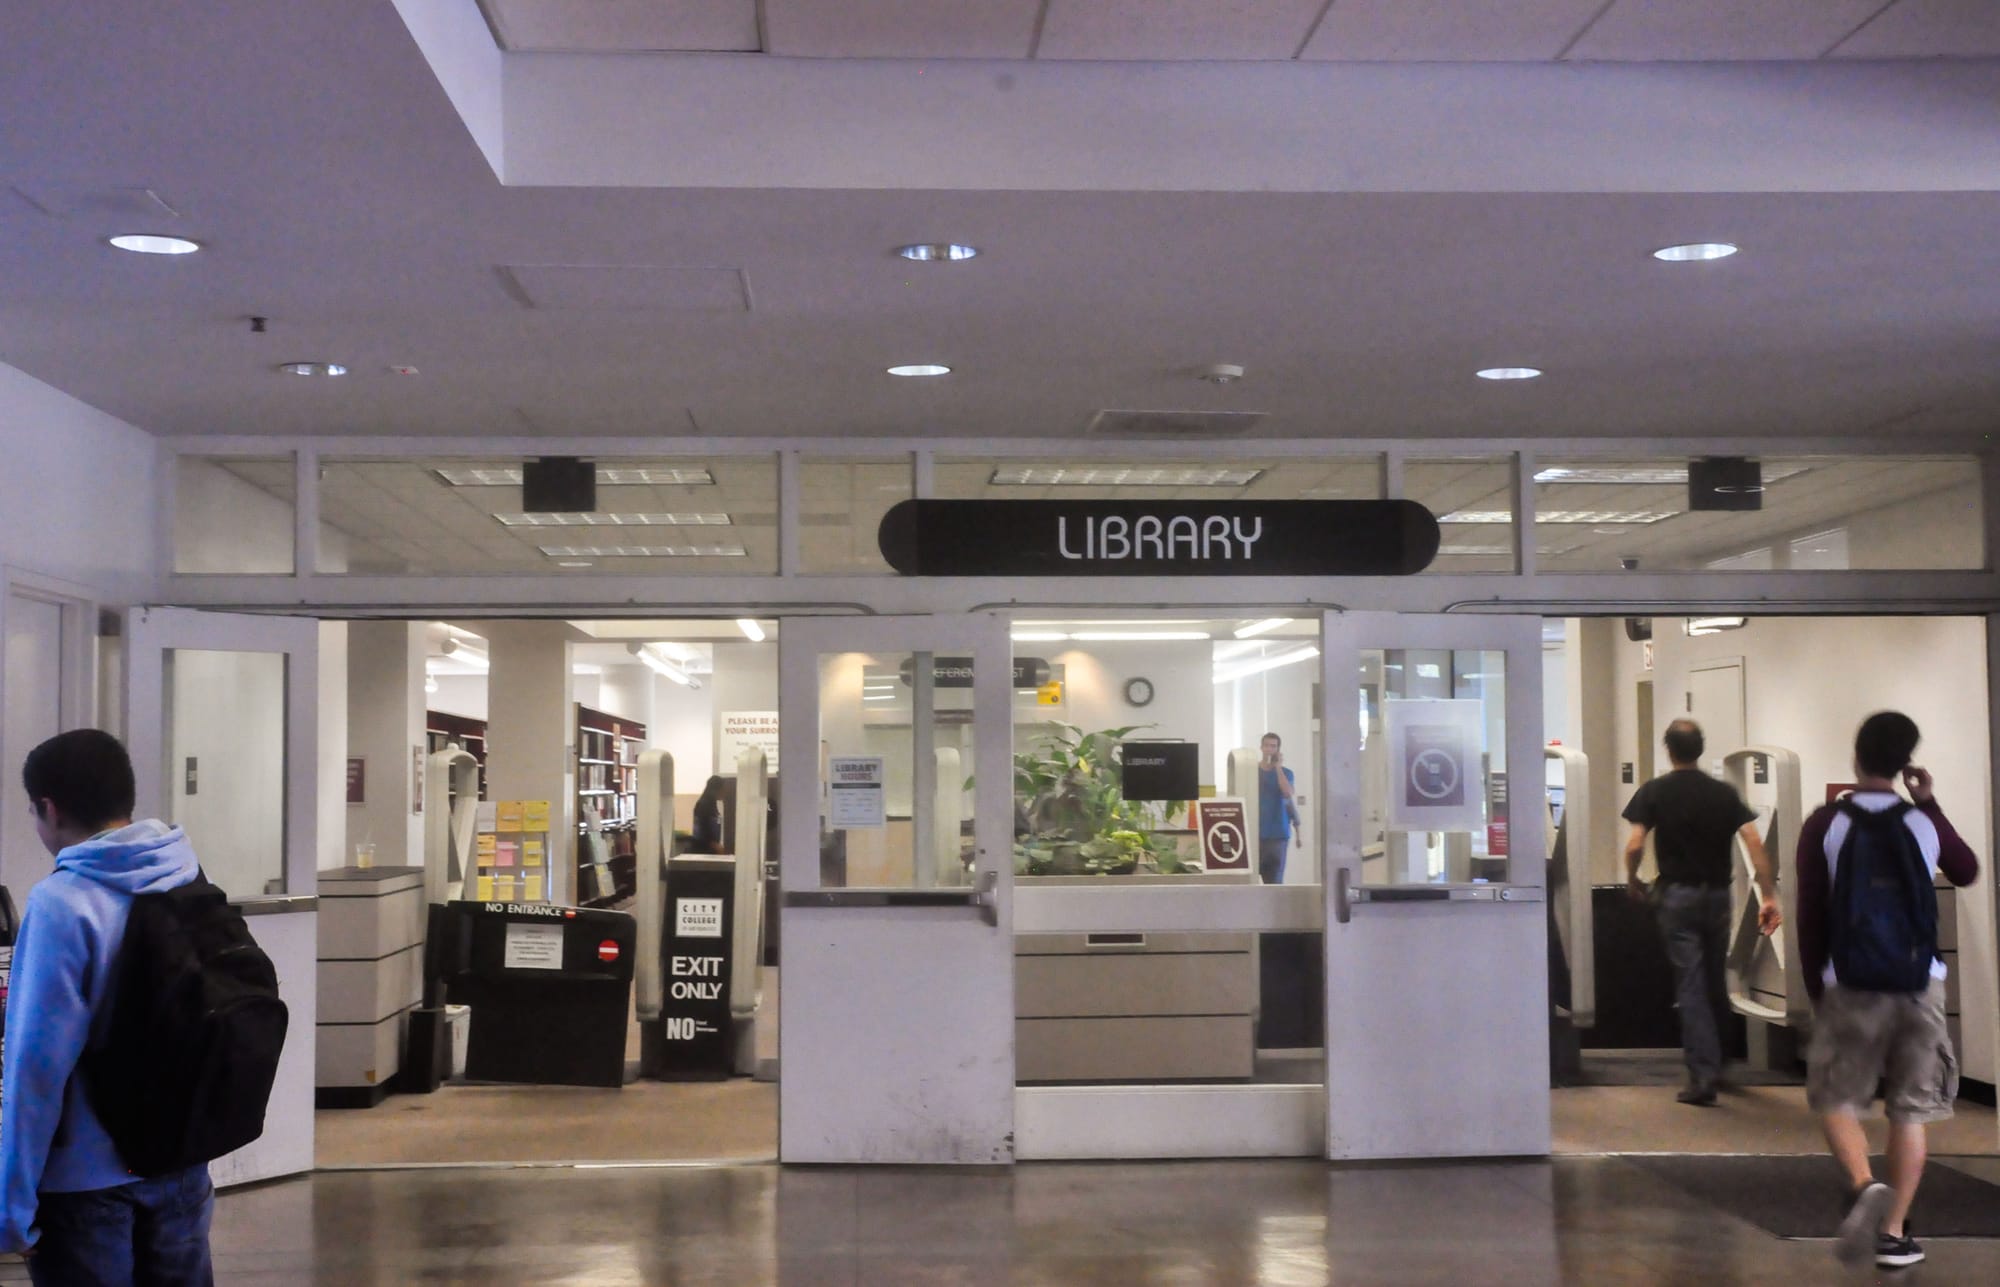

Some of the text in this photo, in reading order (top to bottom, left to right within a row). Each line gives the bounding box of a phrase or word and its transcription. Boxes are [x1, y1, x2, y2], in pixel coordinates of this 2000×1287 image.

[1058, 515, 1262, 560] LIBRARY
[728, 717, 757, 725] PLEASE
[725, 727, 747, 735] YOUR
[835, 763, 878, 773] LIBRARY
[485, 902, 561, 917] NO ENTRANCE
[682, 904, 718, 913] CITY
[682, 916, 717, 924] COLLEGE
[671, 956, 724, 977] EXIT
[671, 981, 723, 1000] ONLY
[666, 1017, 696, 1041] NO
